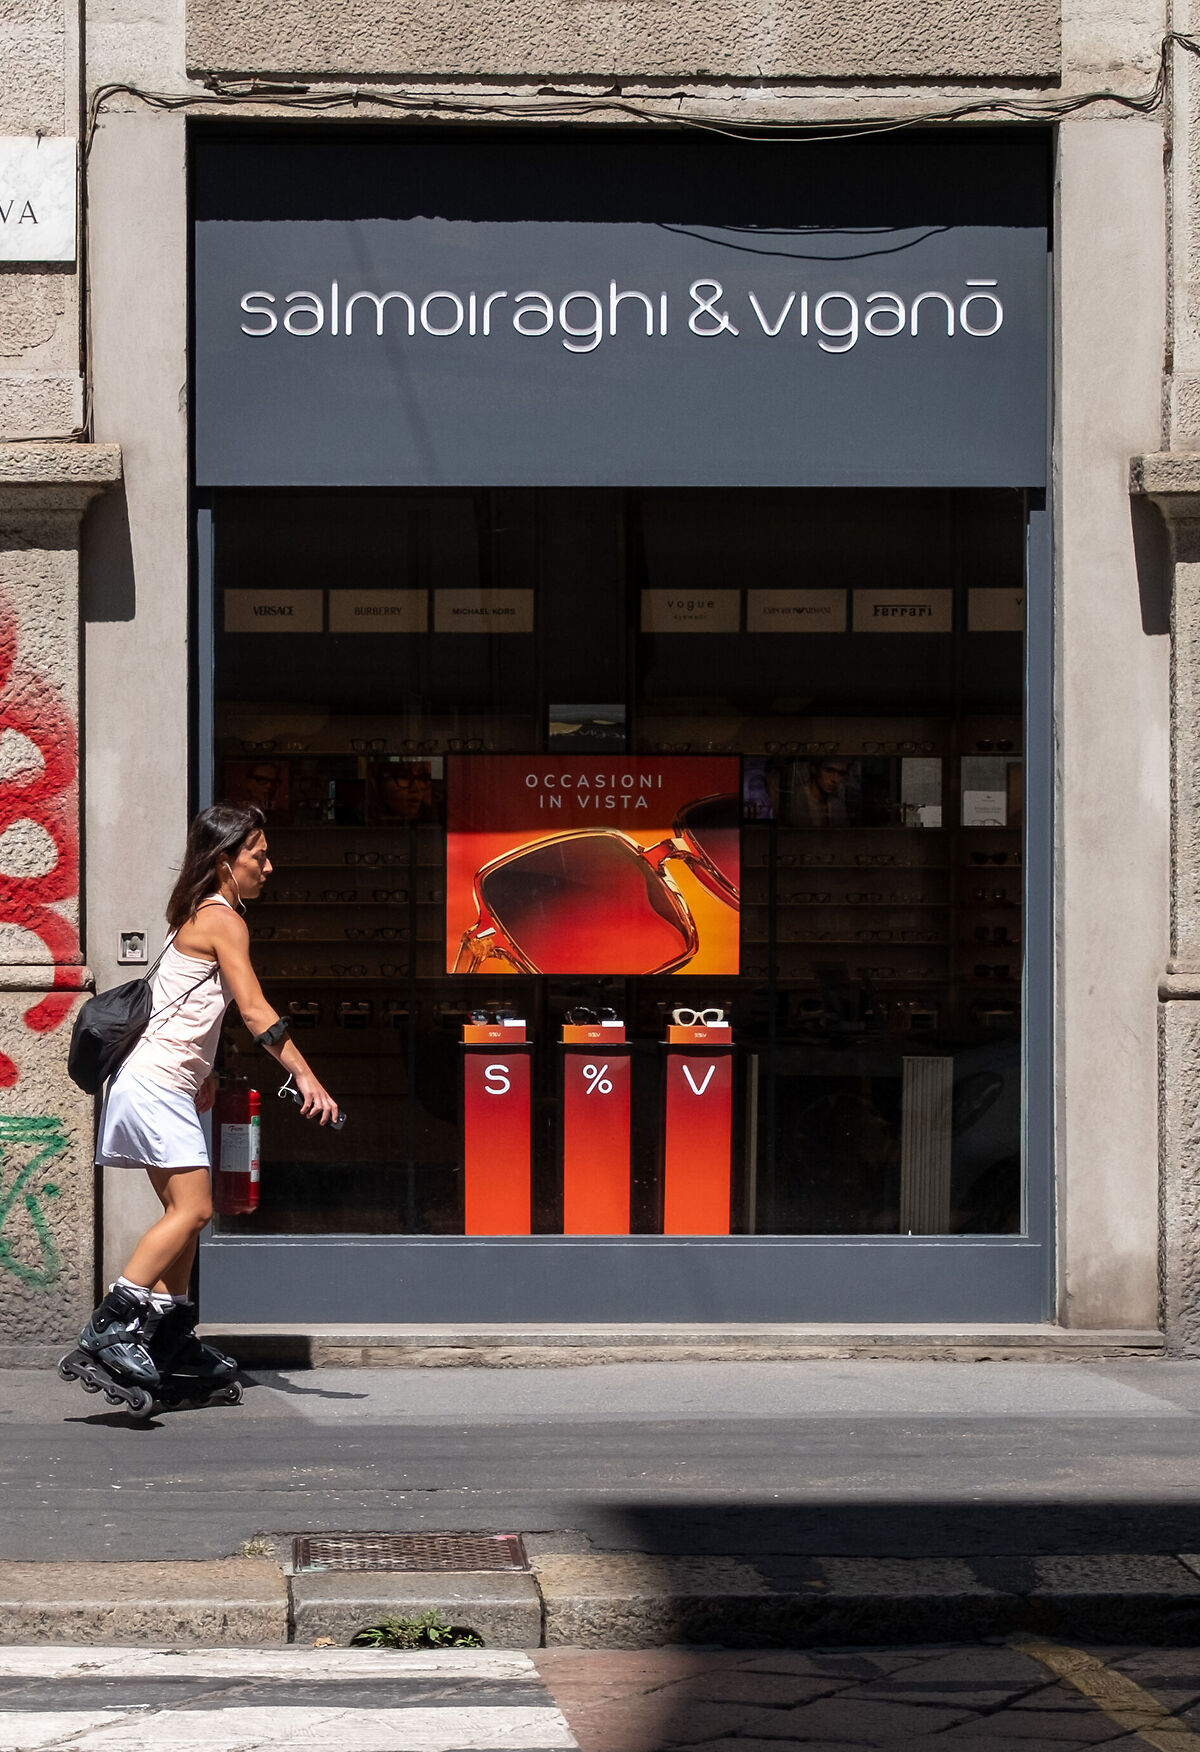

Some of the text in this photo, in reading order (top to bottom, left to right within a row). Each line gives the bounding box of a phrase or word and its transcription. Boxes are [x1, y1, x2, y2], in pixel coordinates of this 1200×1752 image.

[240, 278, 668, 354] salmoiraghi
[688, 278, 740, 337] &
[253, 605, 295, 616] VERSACE
[354, 606, 402, 616] BURBERRY
[452, 607, 516, 616] MICHAEL KORS
[666, 600, 715, 611] vogue
[873, 604, 933, 617] Ferrari
[525, 774, 663, 788] OCCASIONI
[539, 795, 649, 809] IN VISTA
[484, 1064, 716, 1095] S % V
